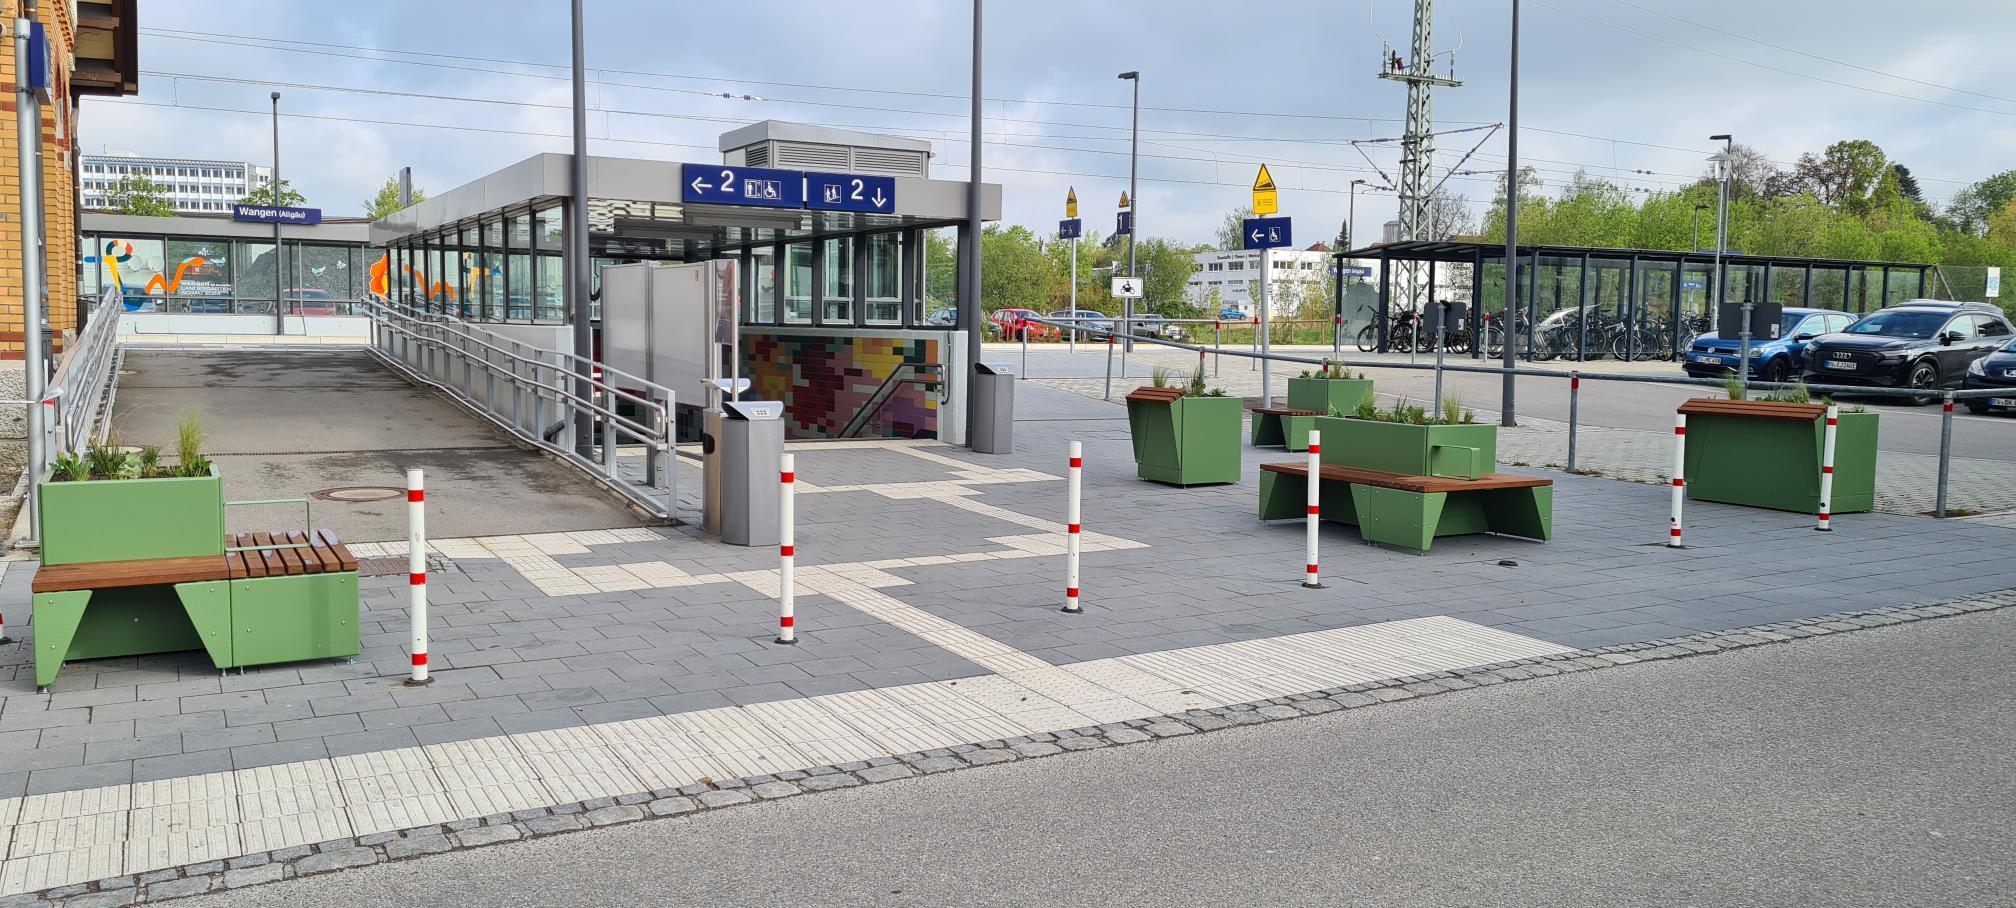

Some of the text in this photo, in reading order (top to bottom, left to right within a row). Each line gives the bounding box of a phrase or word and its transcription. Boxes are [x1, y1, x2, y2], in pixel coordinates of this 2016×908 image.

[720, 170, 734, 192] 2
[851, 179, 864, 200] 2
[239, 206, 306, 219] Wangen (Allgäu)
